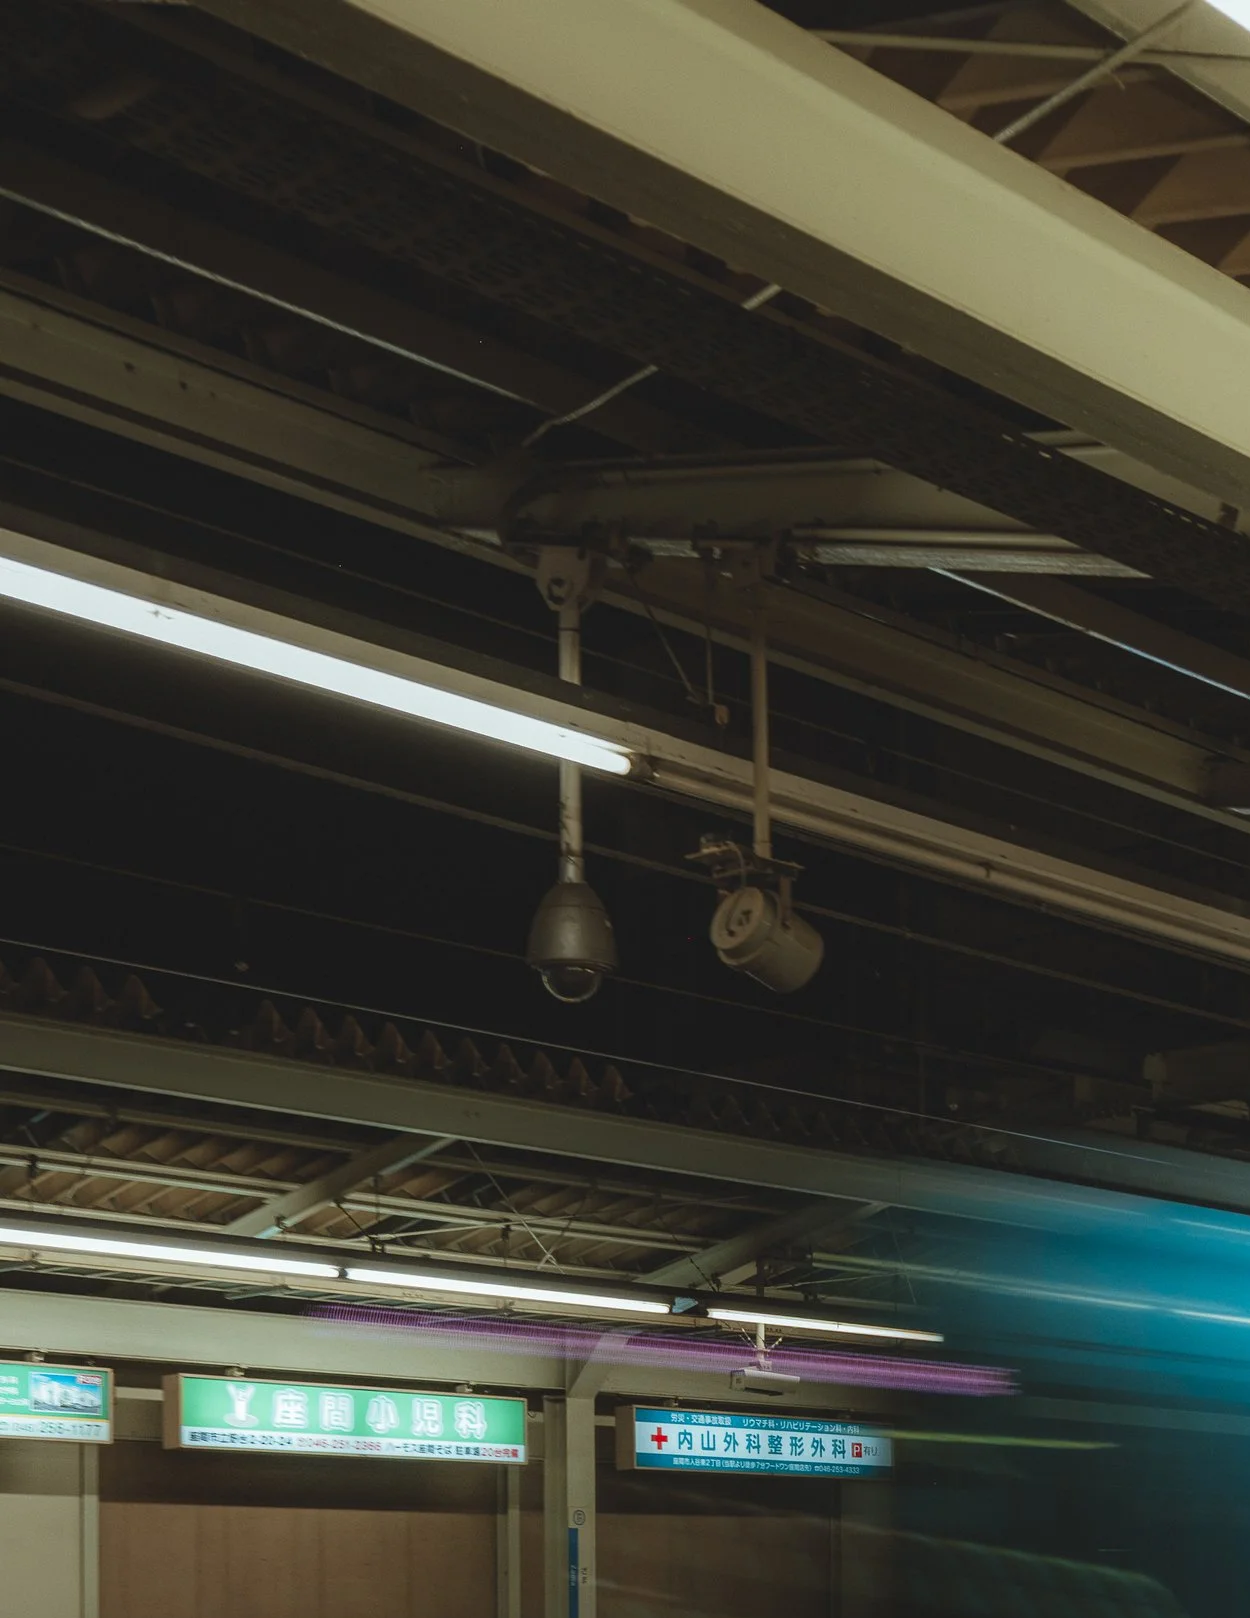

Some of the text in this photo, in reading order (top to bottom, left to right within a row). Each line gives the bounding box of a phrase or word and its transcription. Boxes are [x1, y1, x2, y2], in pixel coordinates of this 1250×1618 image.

[271, 1388, 488, 1440] 座間小児科
[678, 1428, 847, 1460] 内山外科整形外科
